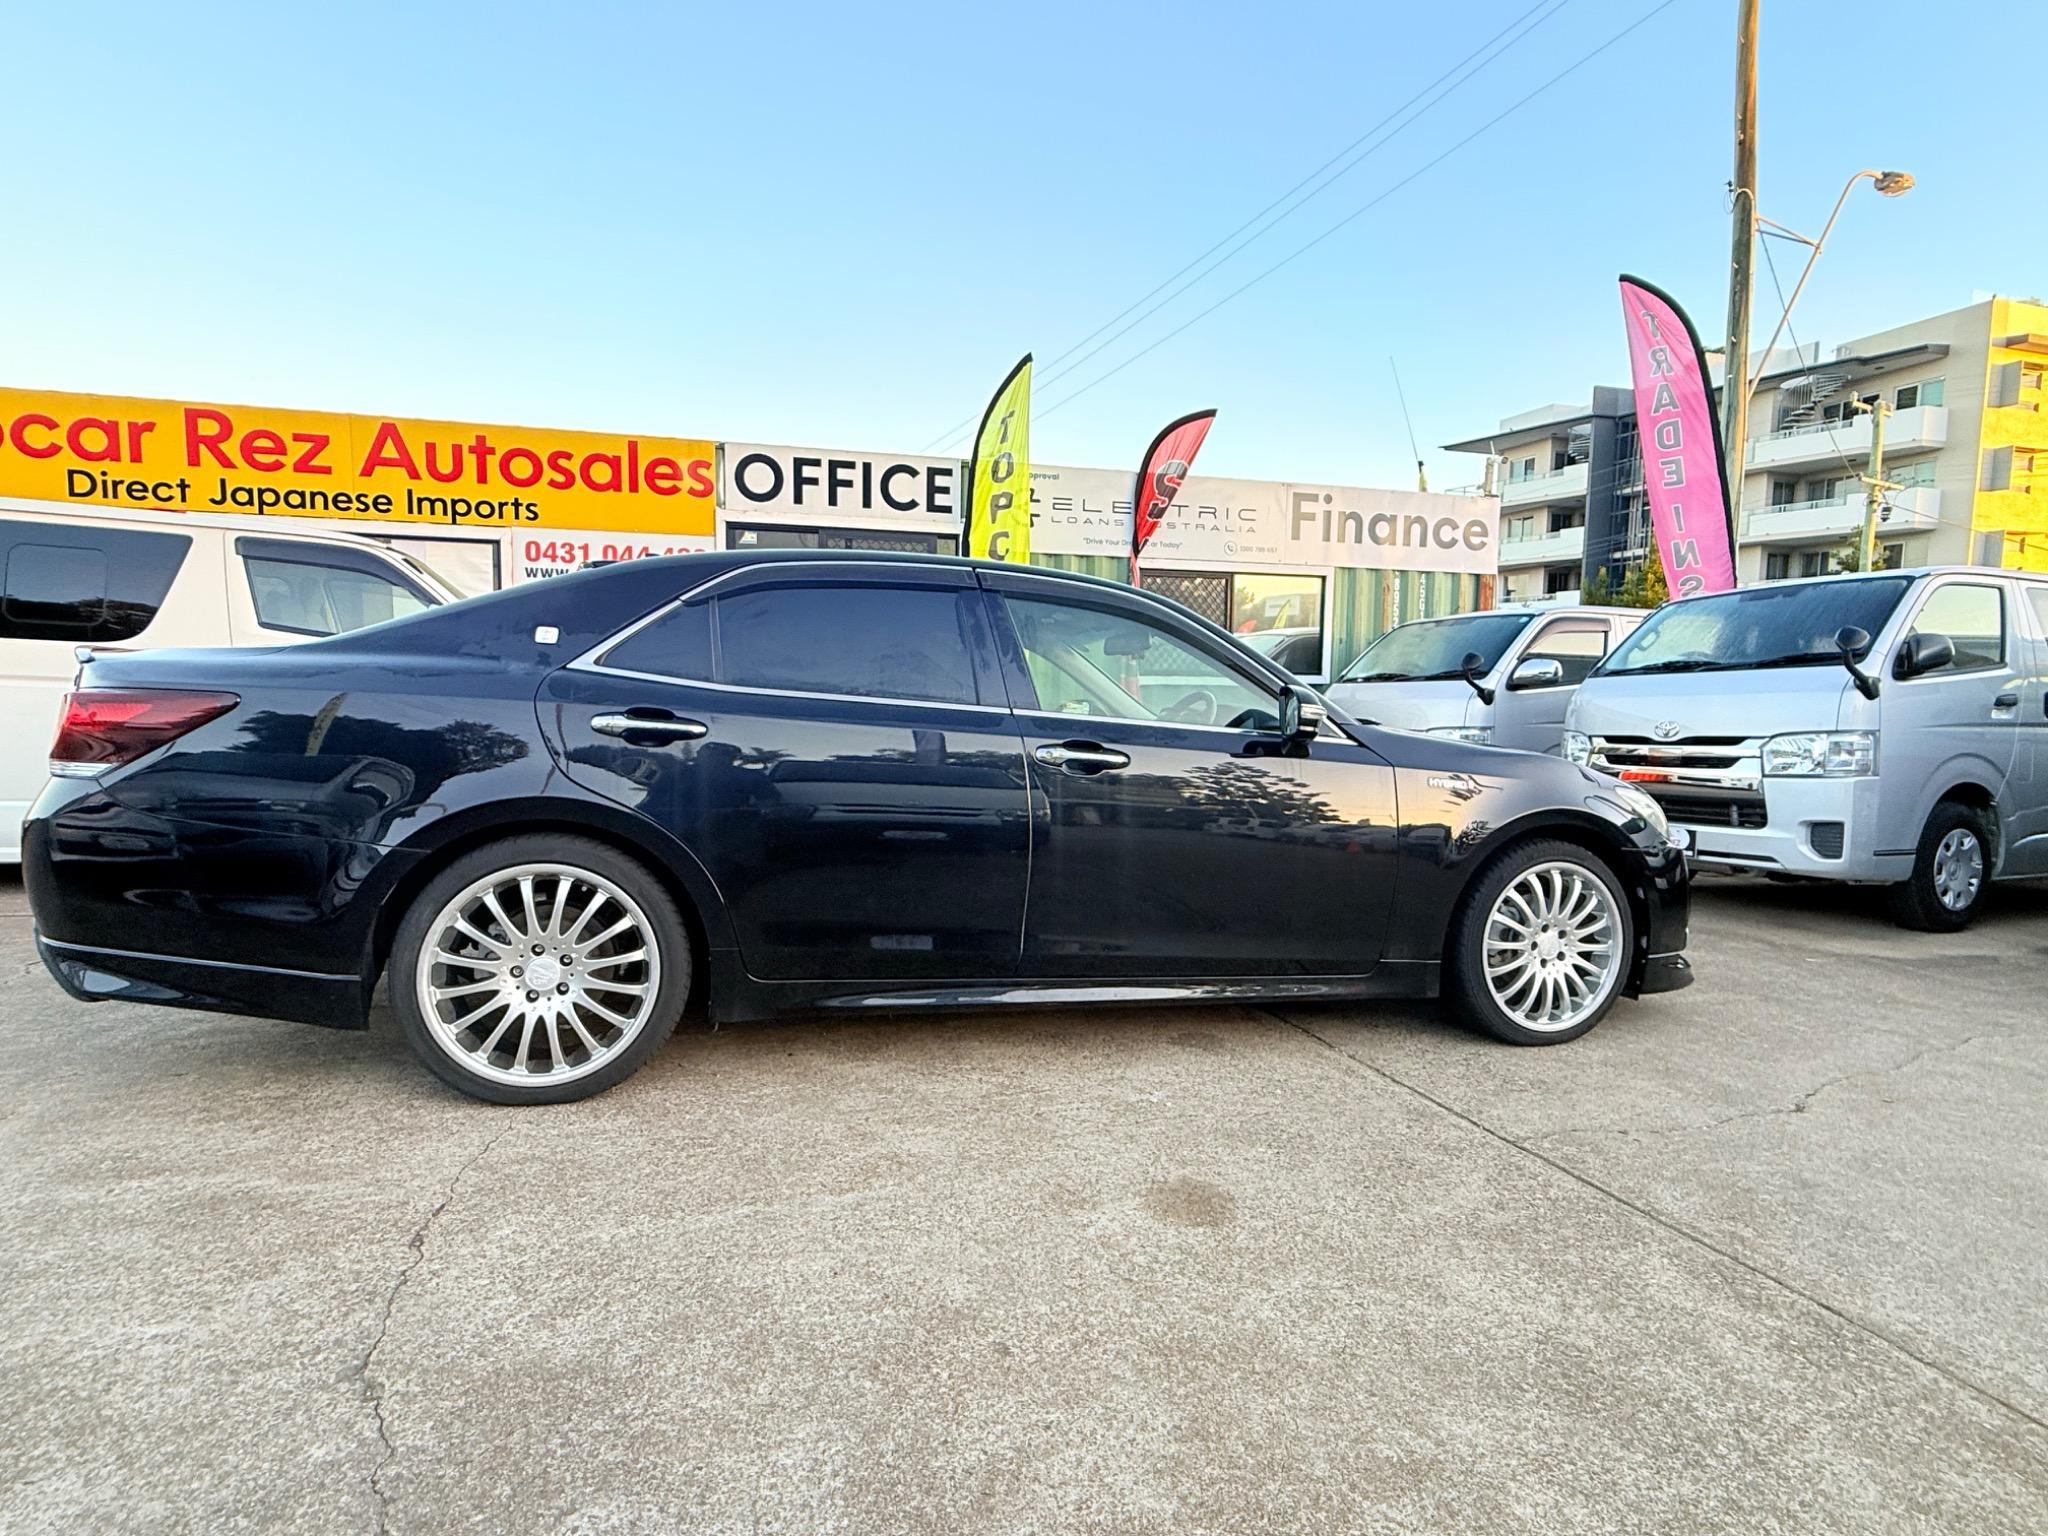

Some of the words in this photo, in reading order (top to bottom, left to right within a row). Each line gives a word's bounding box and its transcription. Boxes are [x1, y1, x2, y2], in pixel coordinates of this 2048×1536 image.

[0, 412, 156, 463] car
[184, 407, 332, 475] Rez
[360, 421, 714, 498] Autosales
[67, 468, 190, 503] Direct
[208, 478, 393, 515] Japanese
[407, 488, 539, 525] Imports
[734, 453, 953, 514] OFFICE
[1052, 497, 1256, 521] ELETRIC
[1051, 516, 1125, 527] LOANS
[1156, 521, 1256, 533] STRALIA
[1291, 491, 1489, 551] Finance
[525, 540, 589, 564] 0431
